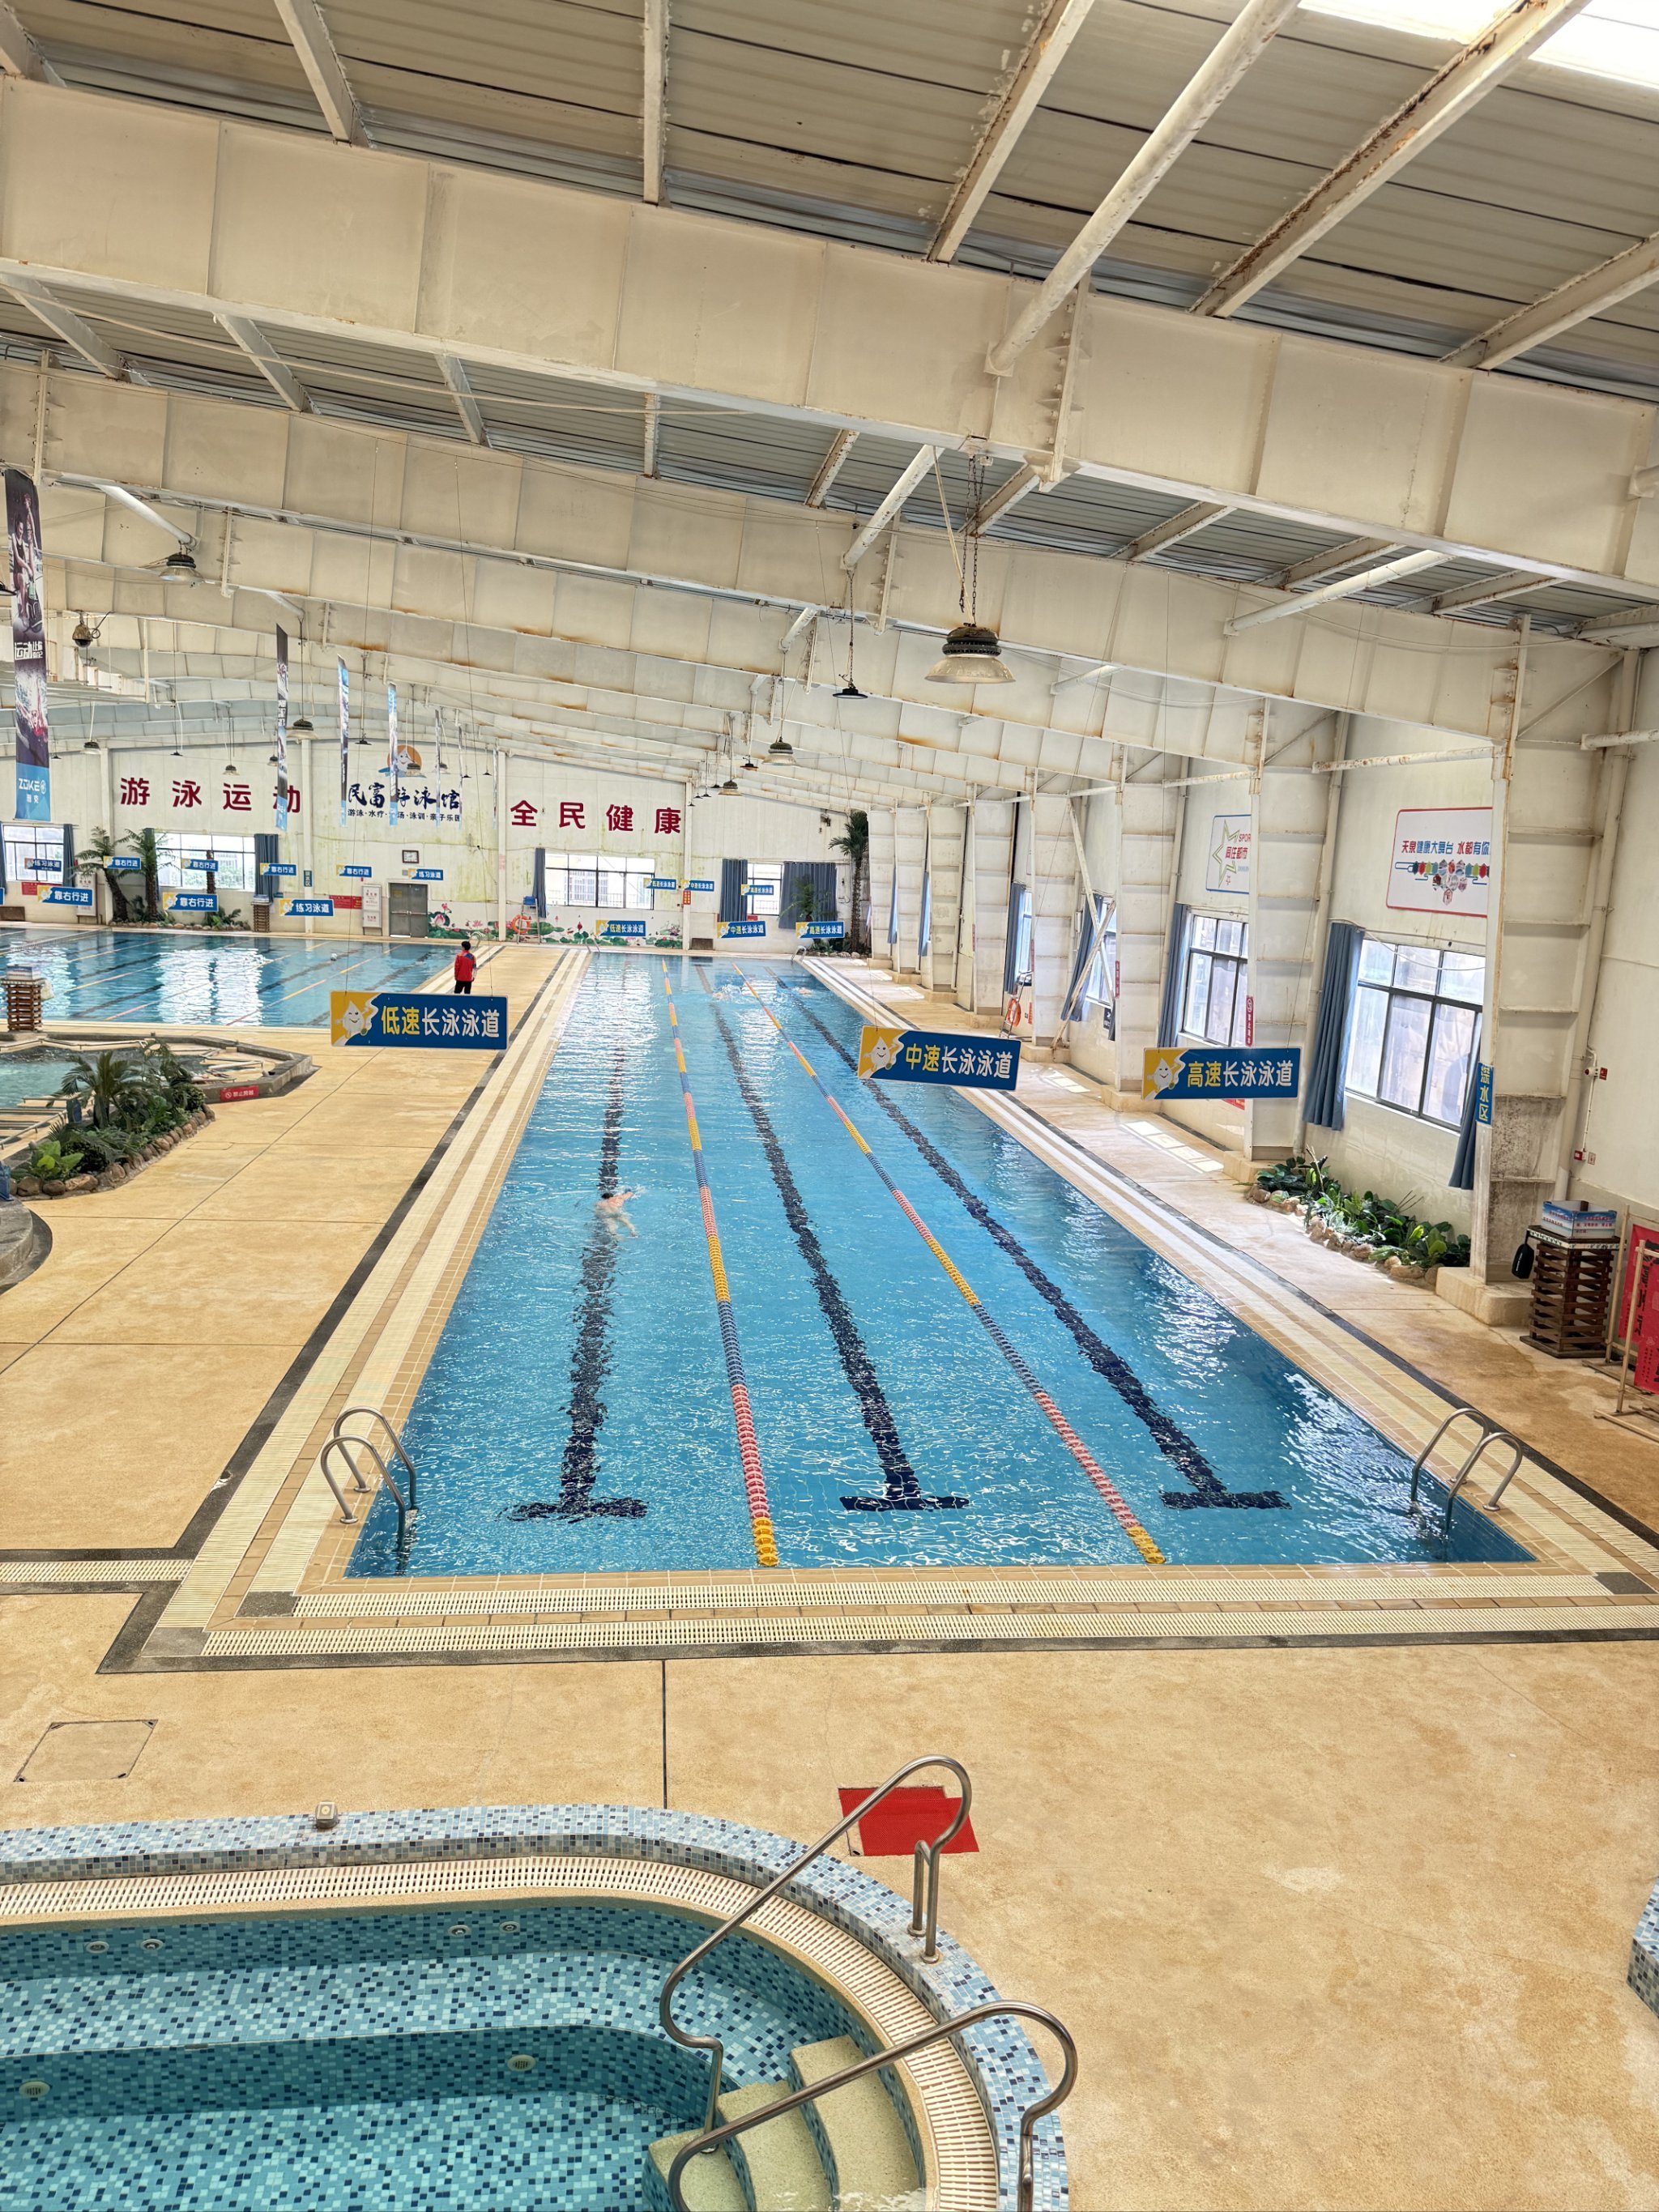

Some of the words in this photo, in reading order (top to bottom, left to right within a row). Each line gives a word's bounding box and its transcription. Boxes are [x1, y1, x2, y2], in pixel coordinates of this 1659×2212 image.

[120, 778, 301, 813] 游泳运动
[510, 799, 682, 835] 全民健康
[1401, 840, 1454, 855] 天泉健康大舞台
[54, 891, 89, 903] 靠右行进
[179, 897, 214, 908] 靠右行进
[296, 902, 330, 914] 练习泳道
[609, 924, 644, 934] 低速长泳泳道
[730, 924, 765, 935] 中速长泳泳道
[381, 1006, 501, 1038] 低速长泳泳道
[905, 1042, 1013, 1080] 中速长泳泳道
[1187, 1060, 1293, 1088] 高速长泳泳道
[1479, 1065, 1491, 1122] 深水区
